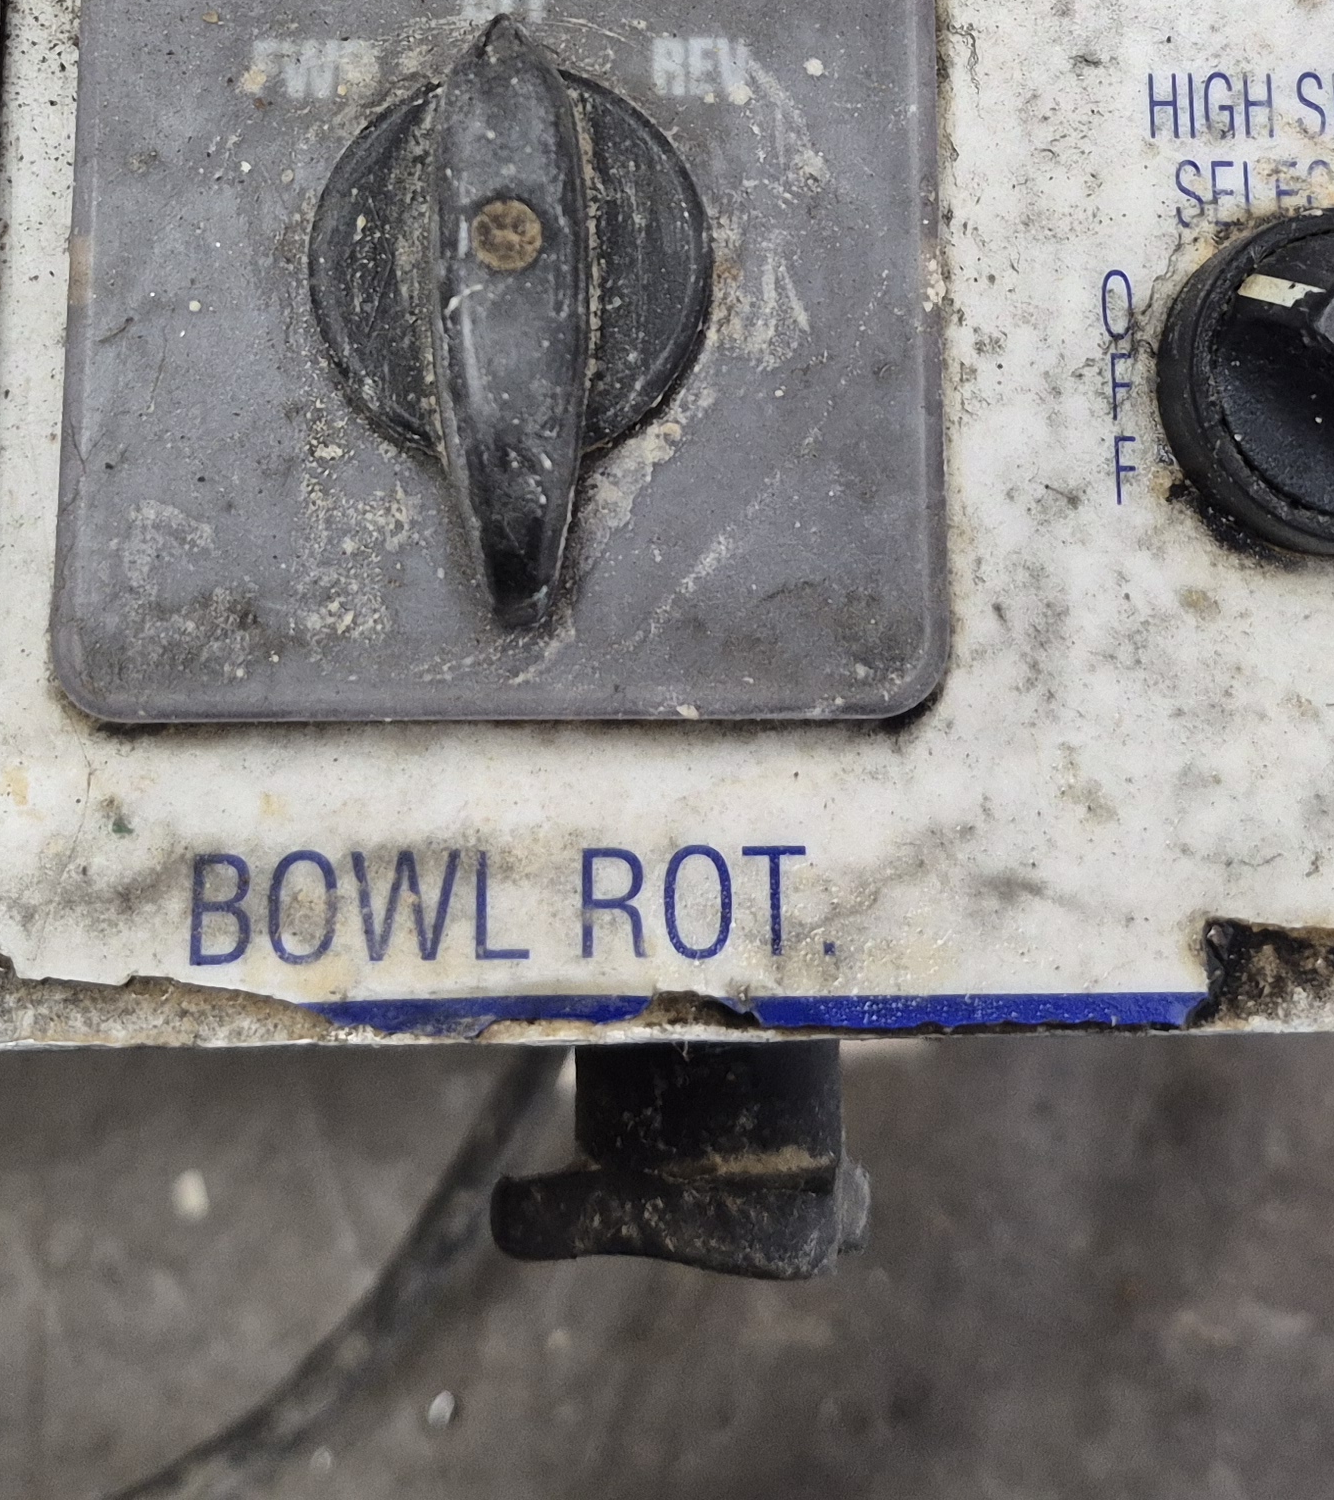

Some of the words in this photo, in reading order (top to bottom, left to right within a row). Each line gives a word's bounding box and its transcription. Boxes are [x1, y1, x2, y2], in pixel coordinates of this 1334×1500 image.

[653, 36, 751, 98] REV
[1148, 72, 1275, 139] HIGH
[189, 849, 530, 966] BOWL
[581, 844, 837, 960] ROT.
